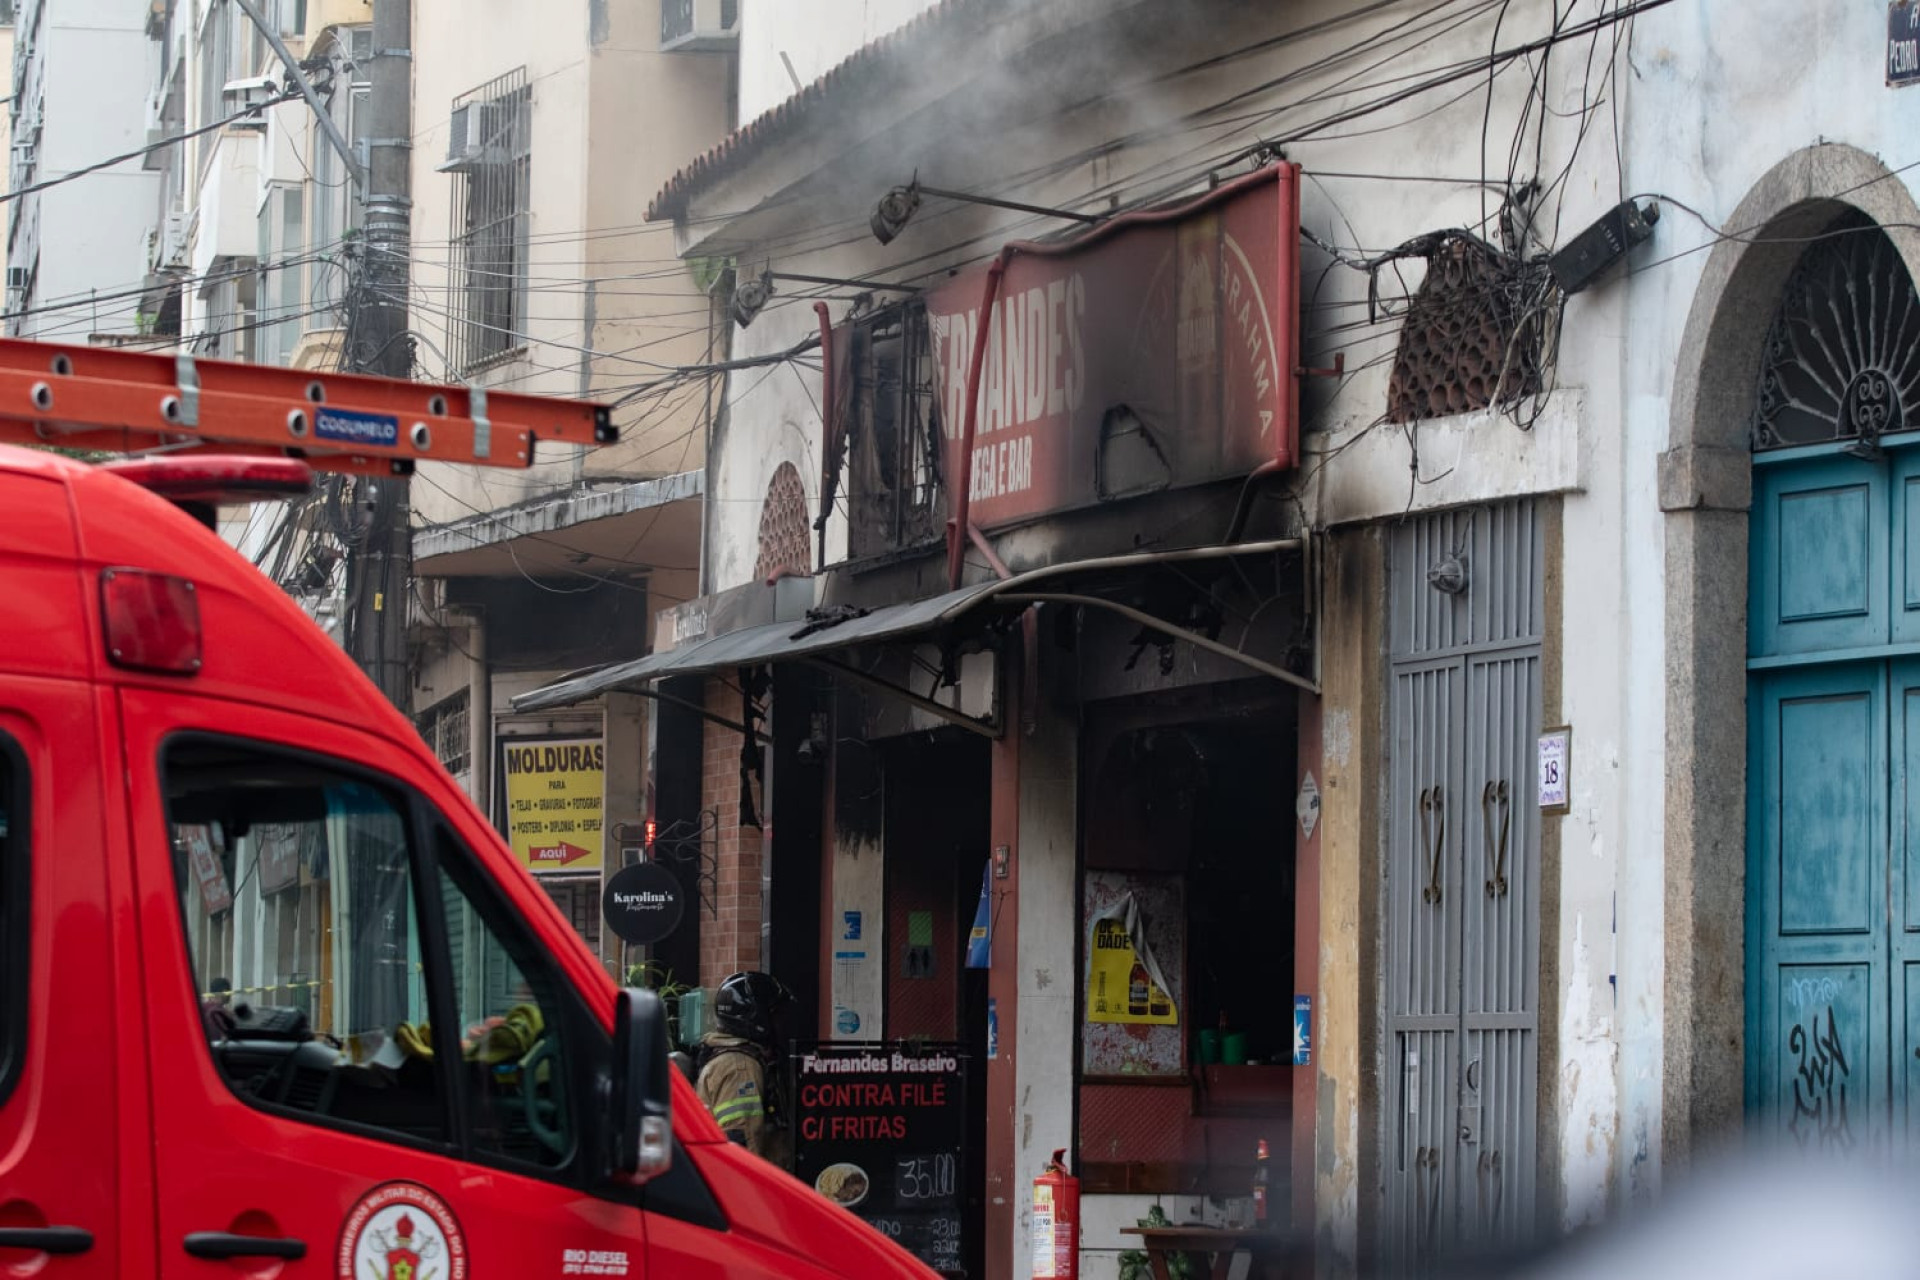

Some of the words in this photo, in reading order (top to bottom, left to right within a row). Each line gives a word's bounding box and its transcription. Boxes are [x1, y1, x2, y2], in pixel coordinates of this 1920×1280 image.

[1890, 39, 1918, 74] PEDRO
[998, 441, 1007, 496] E
[1008, 434, 1033, 493] BAR
[507, 745, 603, 774] MOLDURAS
[1545, 760, 1558, 784] 18
[548, 780, 566, 790] PARA
[517, 821, 542, 834] POSTERS
[614, 890, 674, 903] Karolina's
[803, 1054, 888, 1073] Fernandes
[891, 1053, 957, 1072] Braseiro
[801, 1083, 896, 1107] CONTRA
[901, 1077, 945, 1106] FILÉ
[802, 1116, 824, 1140] C/
[831, 1115, 906, 1140] FRITAS
[898, 1153, 956, 1199] 35,00
[563, 1249, 587, 1262] RIO
[589, 1250, 629, 1264] DIESEL
